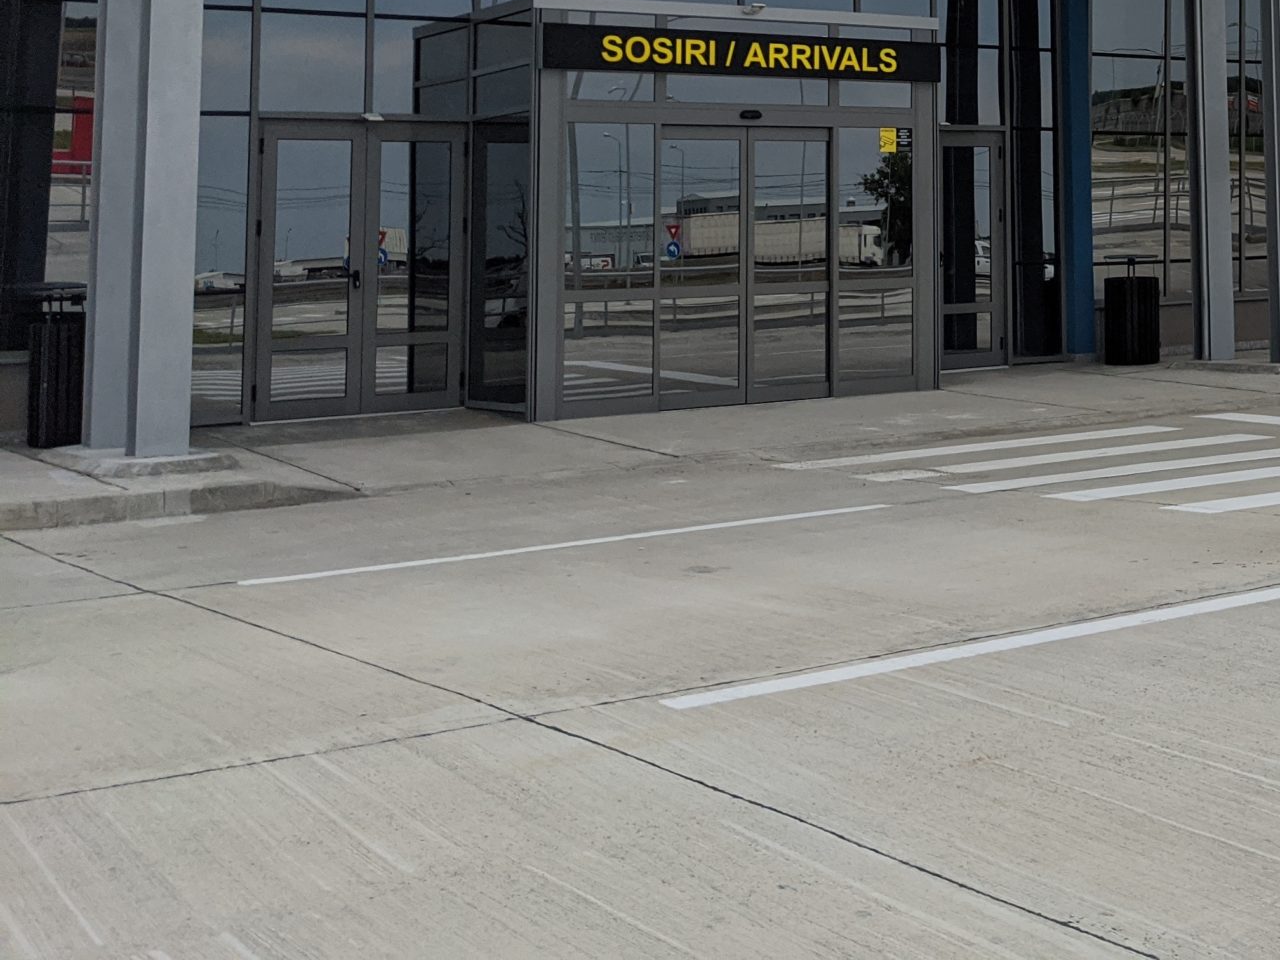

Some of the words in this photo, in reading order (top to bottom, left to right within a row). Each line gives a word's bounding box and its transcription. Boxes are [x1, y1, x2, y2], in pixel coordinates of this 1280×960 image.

[601, 35, 717, 67] SOSIRI
[725, 41, 736, 67] /
[744, 42, 898, 73] ARRIVALS
